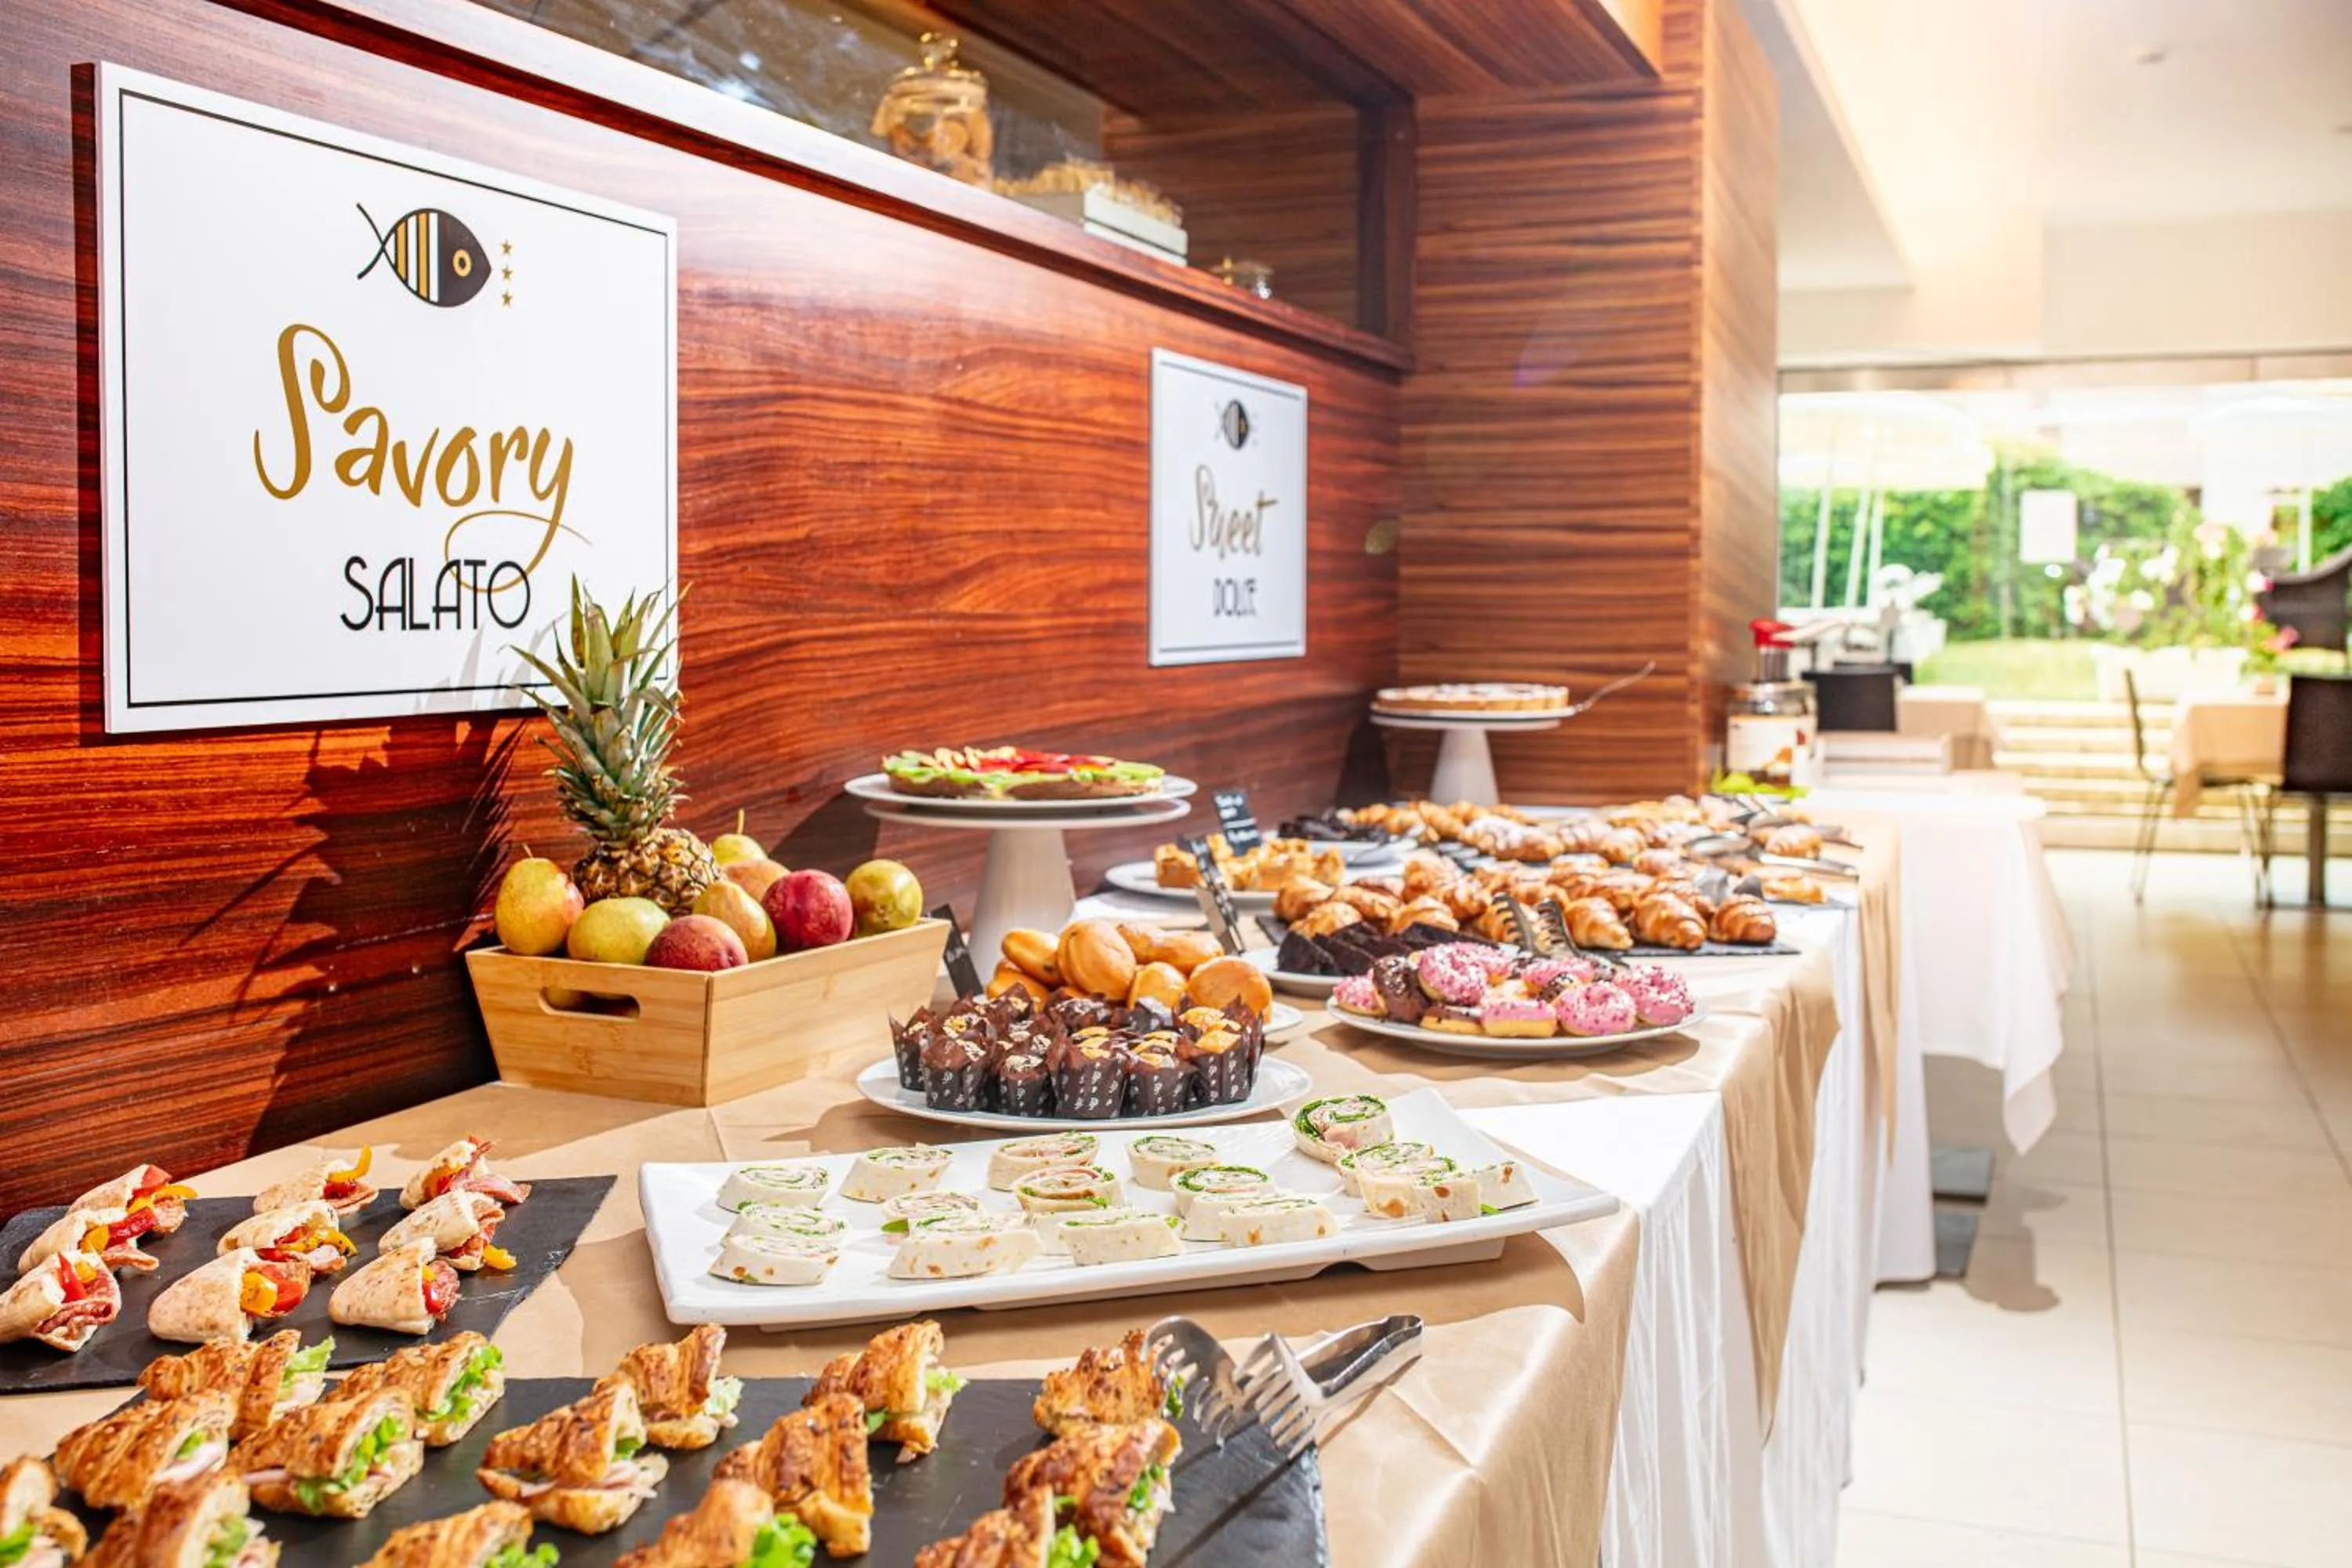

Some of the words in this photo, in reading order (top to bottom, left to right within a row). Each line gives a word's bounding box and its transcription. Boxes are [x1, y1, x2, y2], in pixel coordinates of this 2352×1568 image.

[254, 324, 593, 592] Savory
[1189, 463, 1279, 561] Sweet
[340, 556, 531, 631] SALATO
